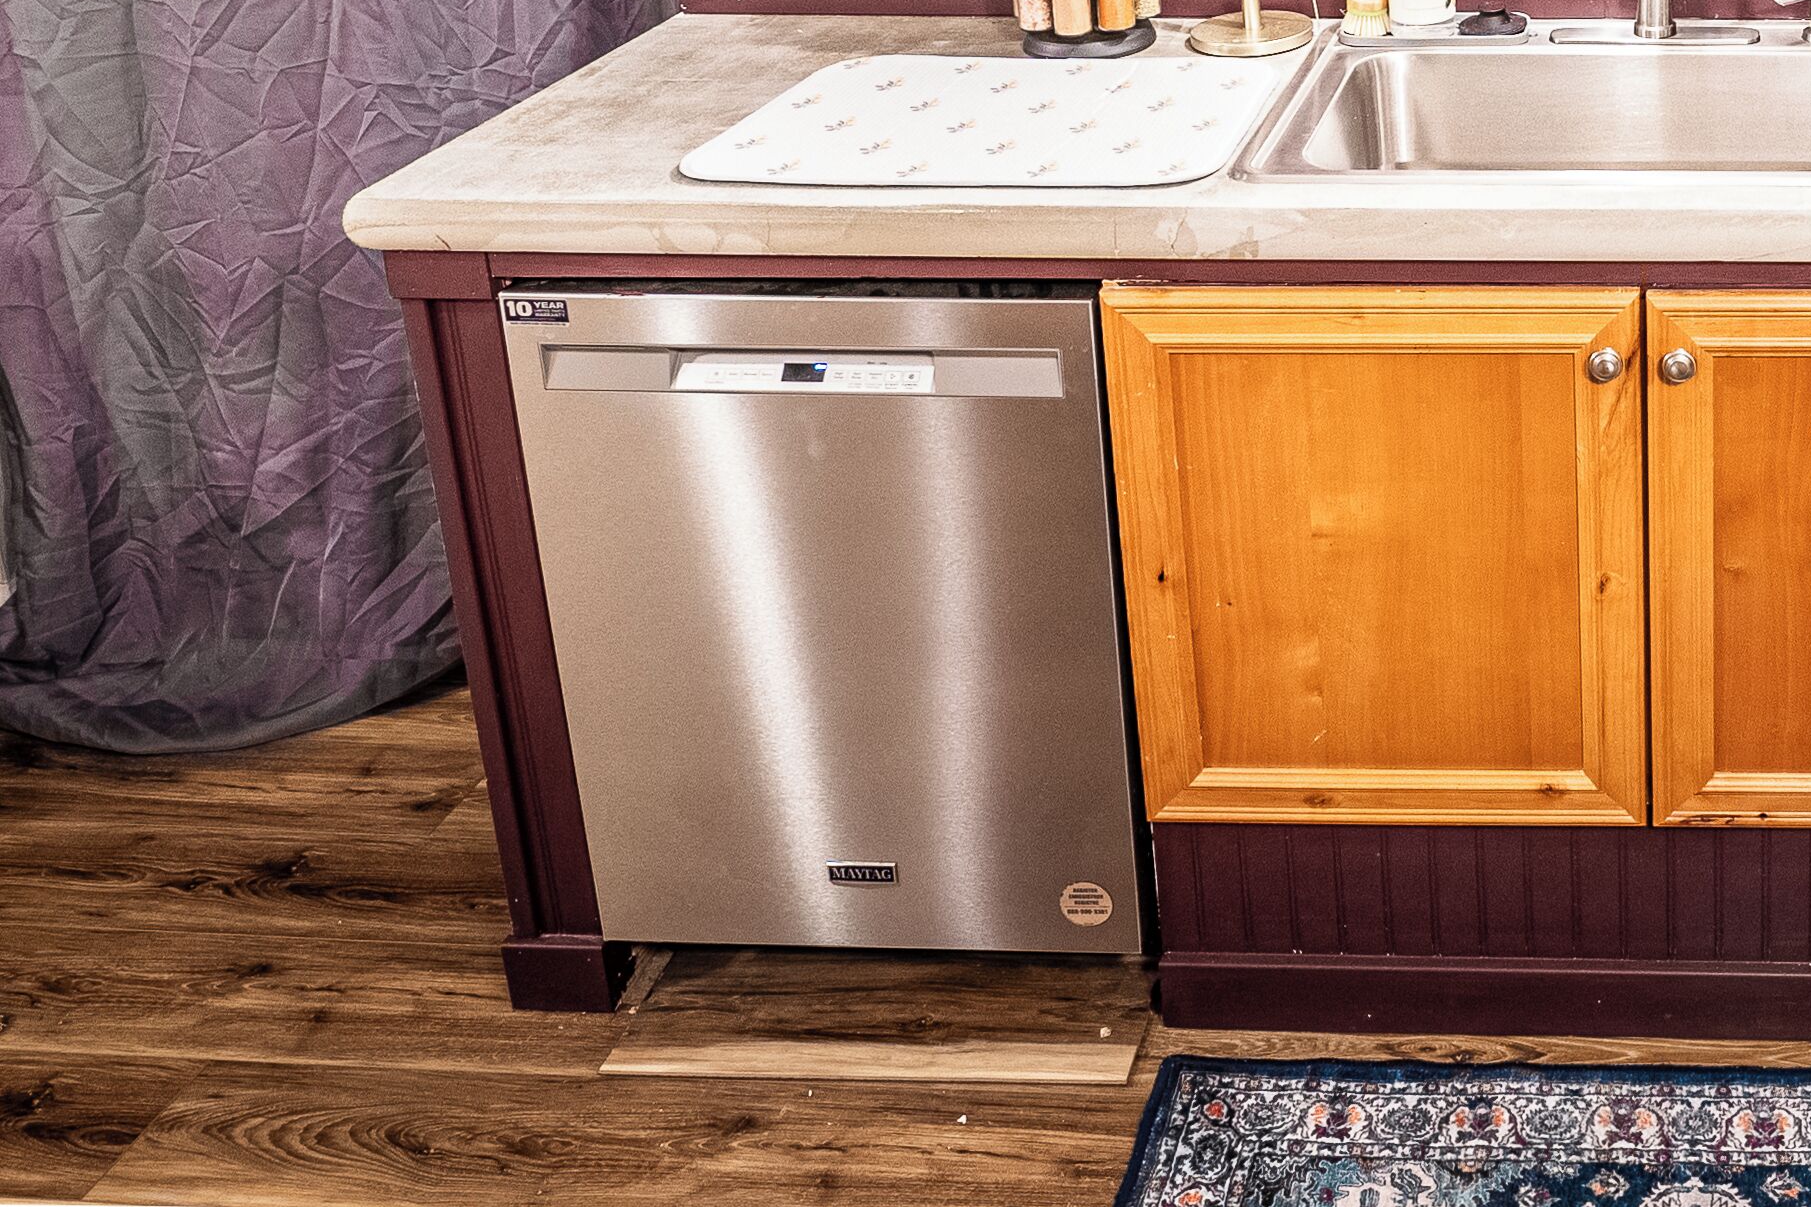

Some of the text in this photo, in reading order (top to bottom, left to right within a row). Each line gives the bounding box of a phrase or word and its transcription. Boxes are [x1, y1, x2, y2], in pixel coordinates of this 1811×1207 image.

[506, 300, 565, 317] 10 YEAR
[832, 867, 892, 880] MAYTAG
